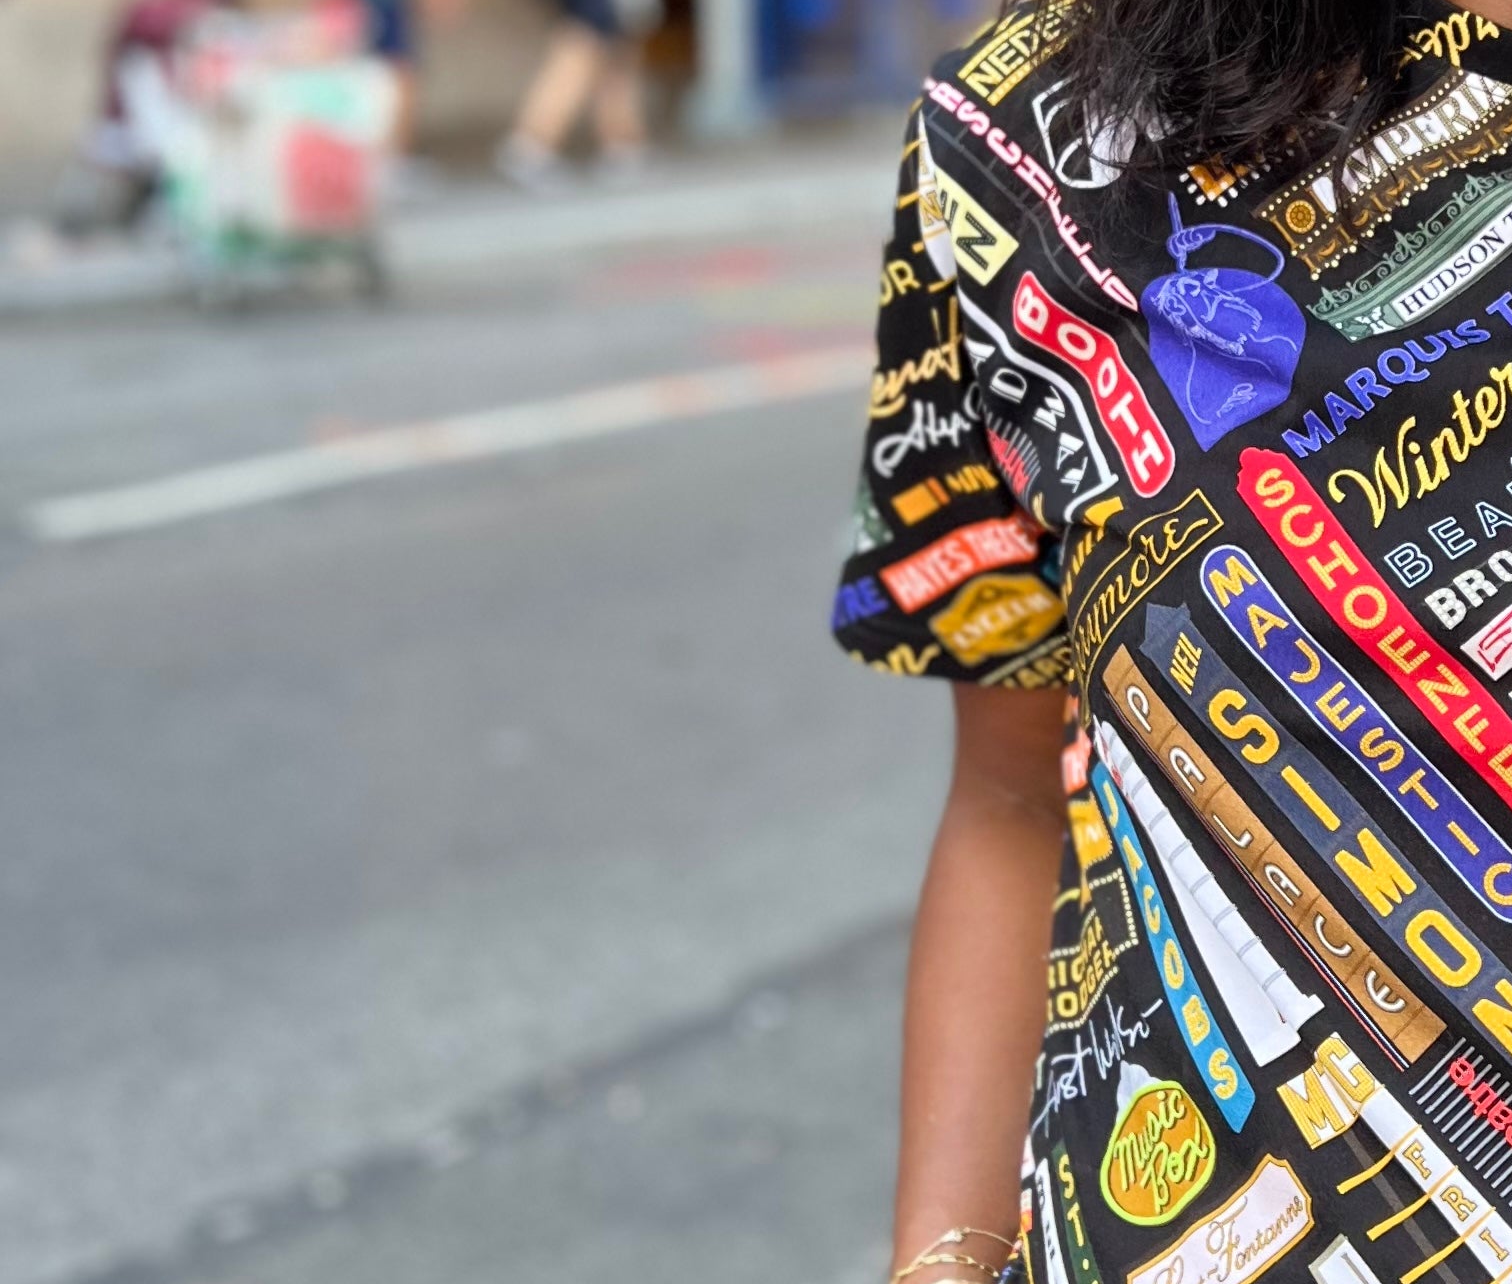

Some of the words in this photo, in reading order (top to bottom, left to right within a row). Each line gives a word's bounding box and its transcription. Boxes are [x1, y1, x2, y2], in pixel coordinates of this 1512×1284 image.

[1400, 226, 1504, 316] HUDSON
[1017, 285, 1165, 485] BOOTH
[1282, 318, 1491, 458] MARQUIS
[1169, 631, 1203, 696] NEIL
[1127, 685, 1405, 1013] PALACE
[1103, 780, 1239, 1100] JACOBS
[1115, 1090, 1185, 1192] Music
[1141, 1116, 1209, 1215] Box
